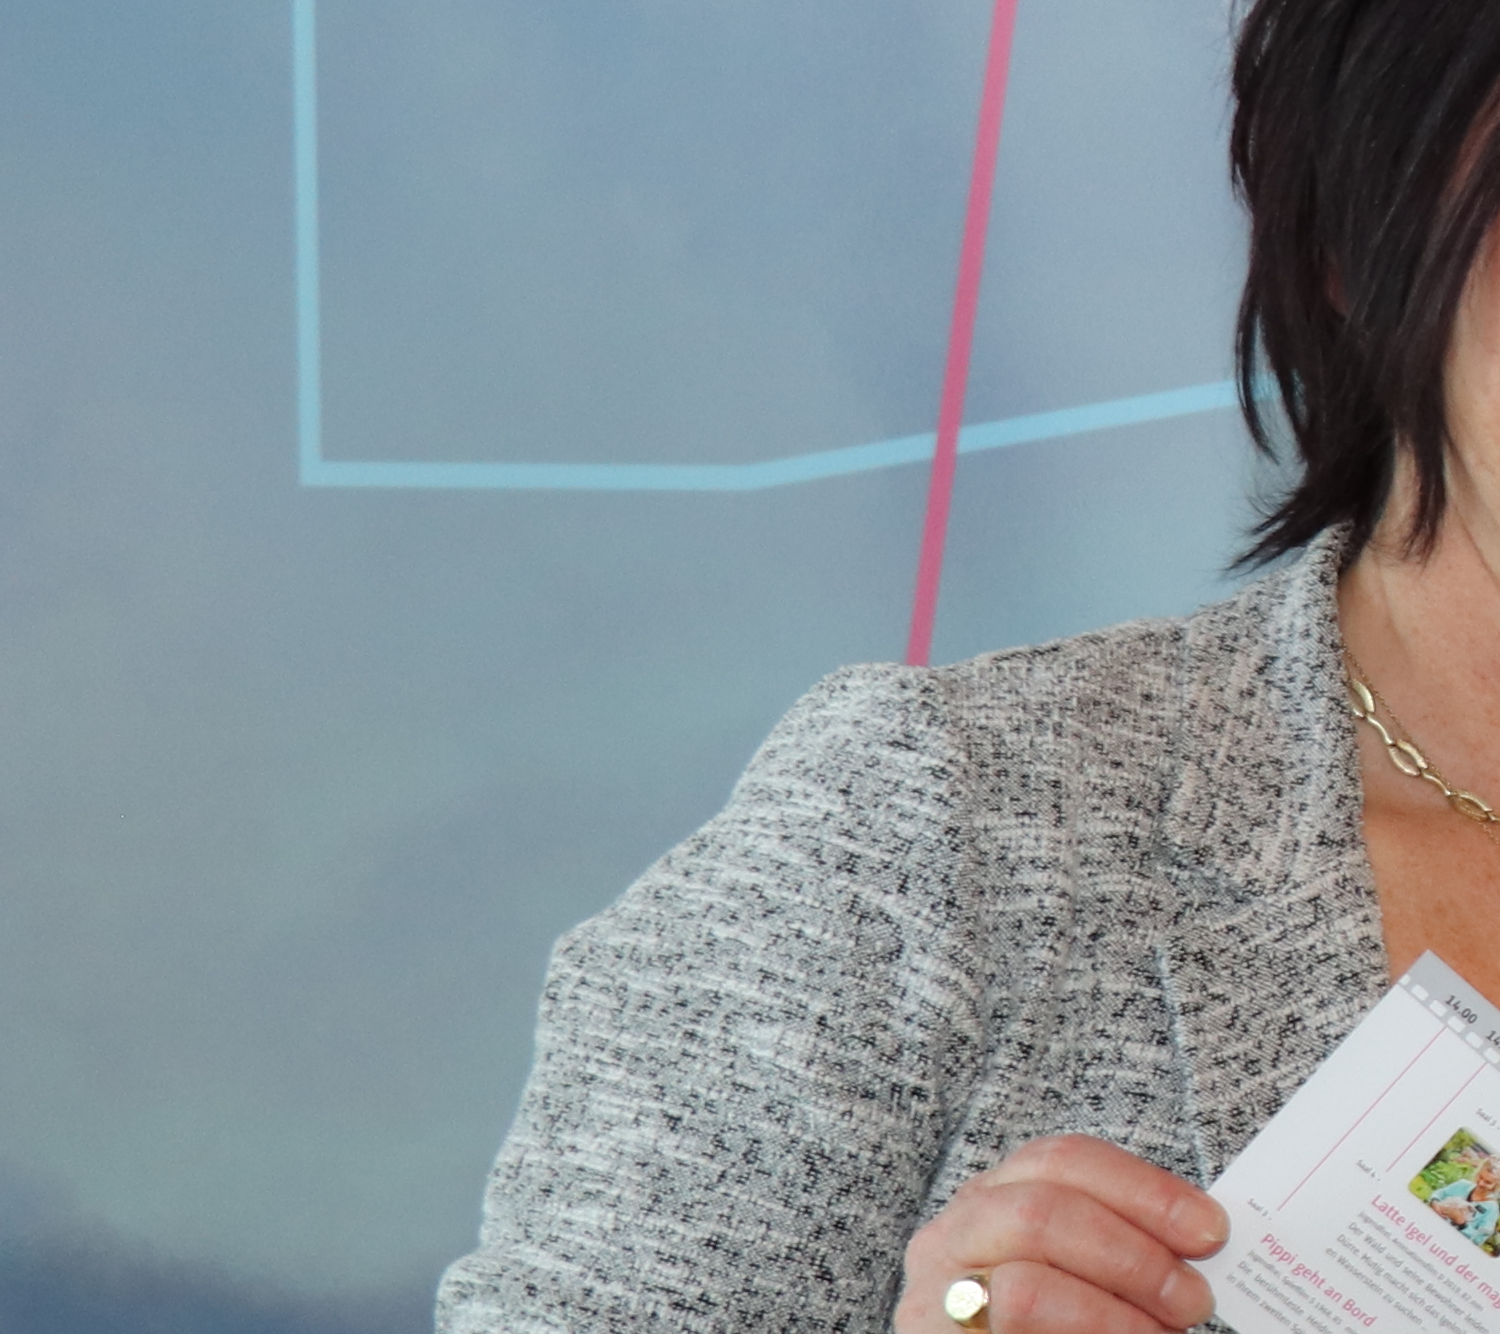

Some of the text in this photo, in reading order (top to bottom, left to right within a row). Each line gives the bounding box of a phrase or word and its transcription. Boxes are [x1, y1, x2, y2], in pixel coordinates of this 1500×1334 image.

[1445, 995, 1477, 1023] 14.00
[1261, 1231, 1376, 1329] Pippi geht an Bord
[1371, 1193, 1404, 1225] Latte
[1402, 1219, 1432, 1248] Igel
[1429, 1240, 1457, 1268] und
[1455, 1261, 1478, 1282] der
